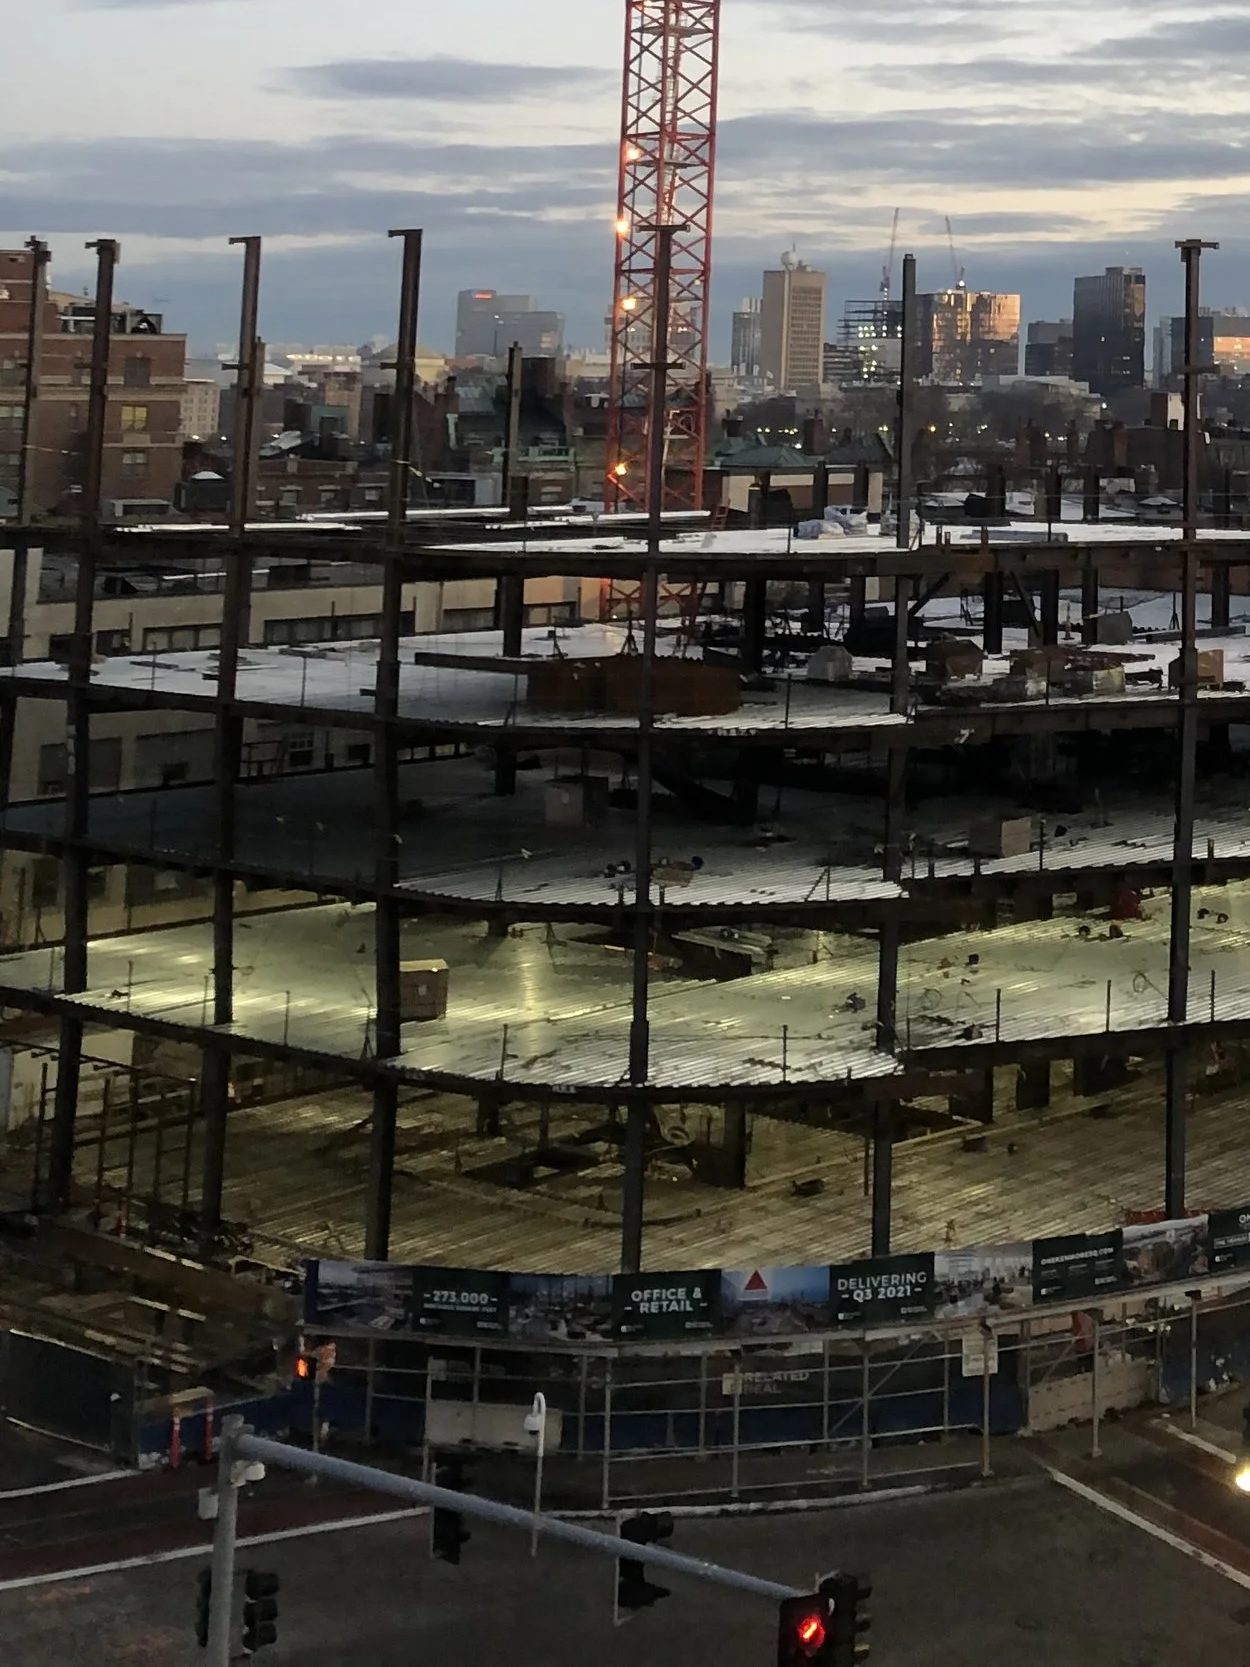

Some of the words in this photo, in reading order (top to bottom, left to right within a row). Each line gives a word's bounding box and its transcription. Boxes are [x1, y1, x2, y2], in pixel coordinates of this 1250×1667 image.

[836, 1271, 928, 1291] DELIVERING
[630, 1287, 688, 1302] OFFICE
[692, 1286, 703, 1299] &
[852, 1288, 873, 1303] Q3
[877, 1285, 911, 1300] 2021
[639, 1300, 694, 1315] RETAIL
